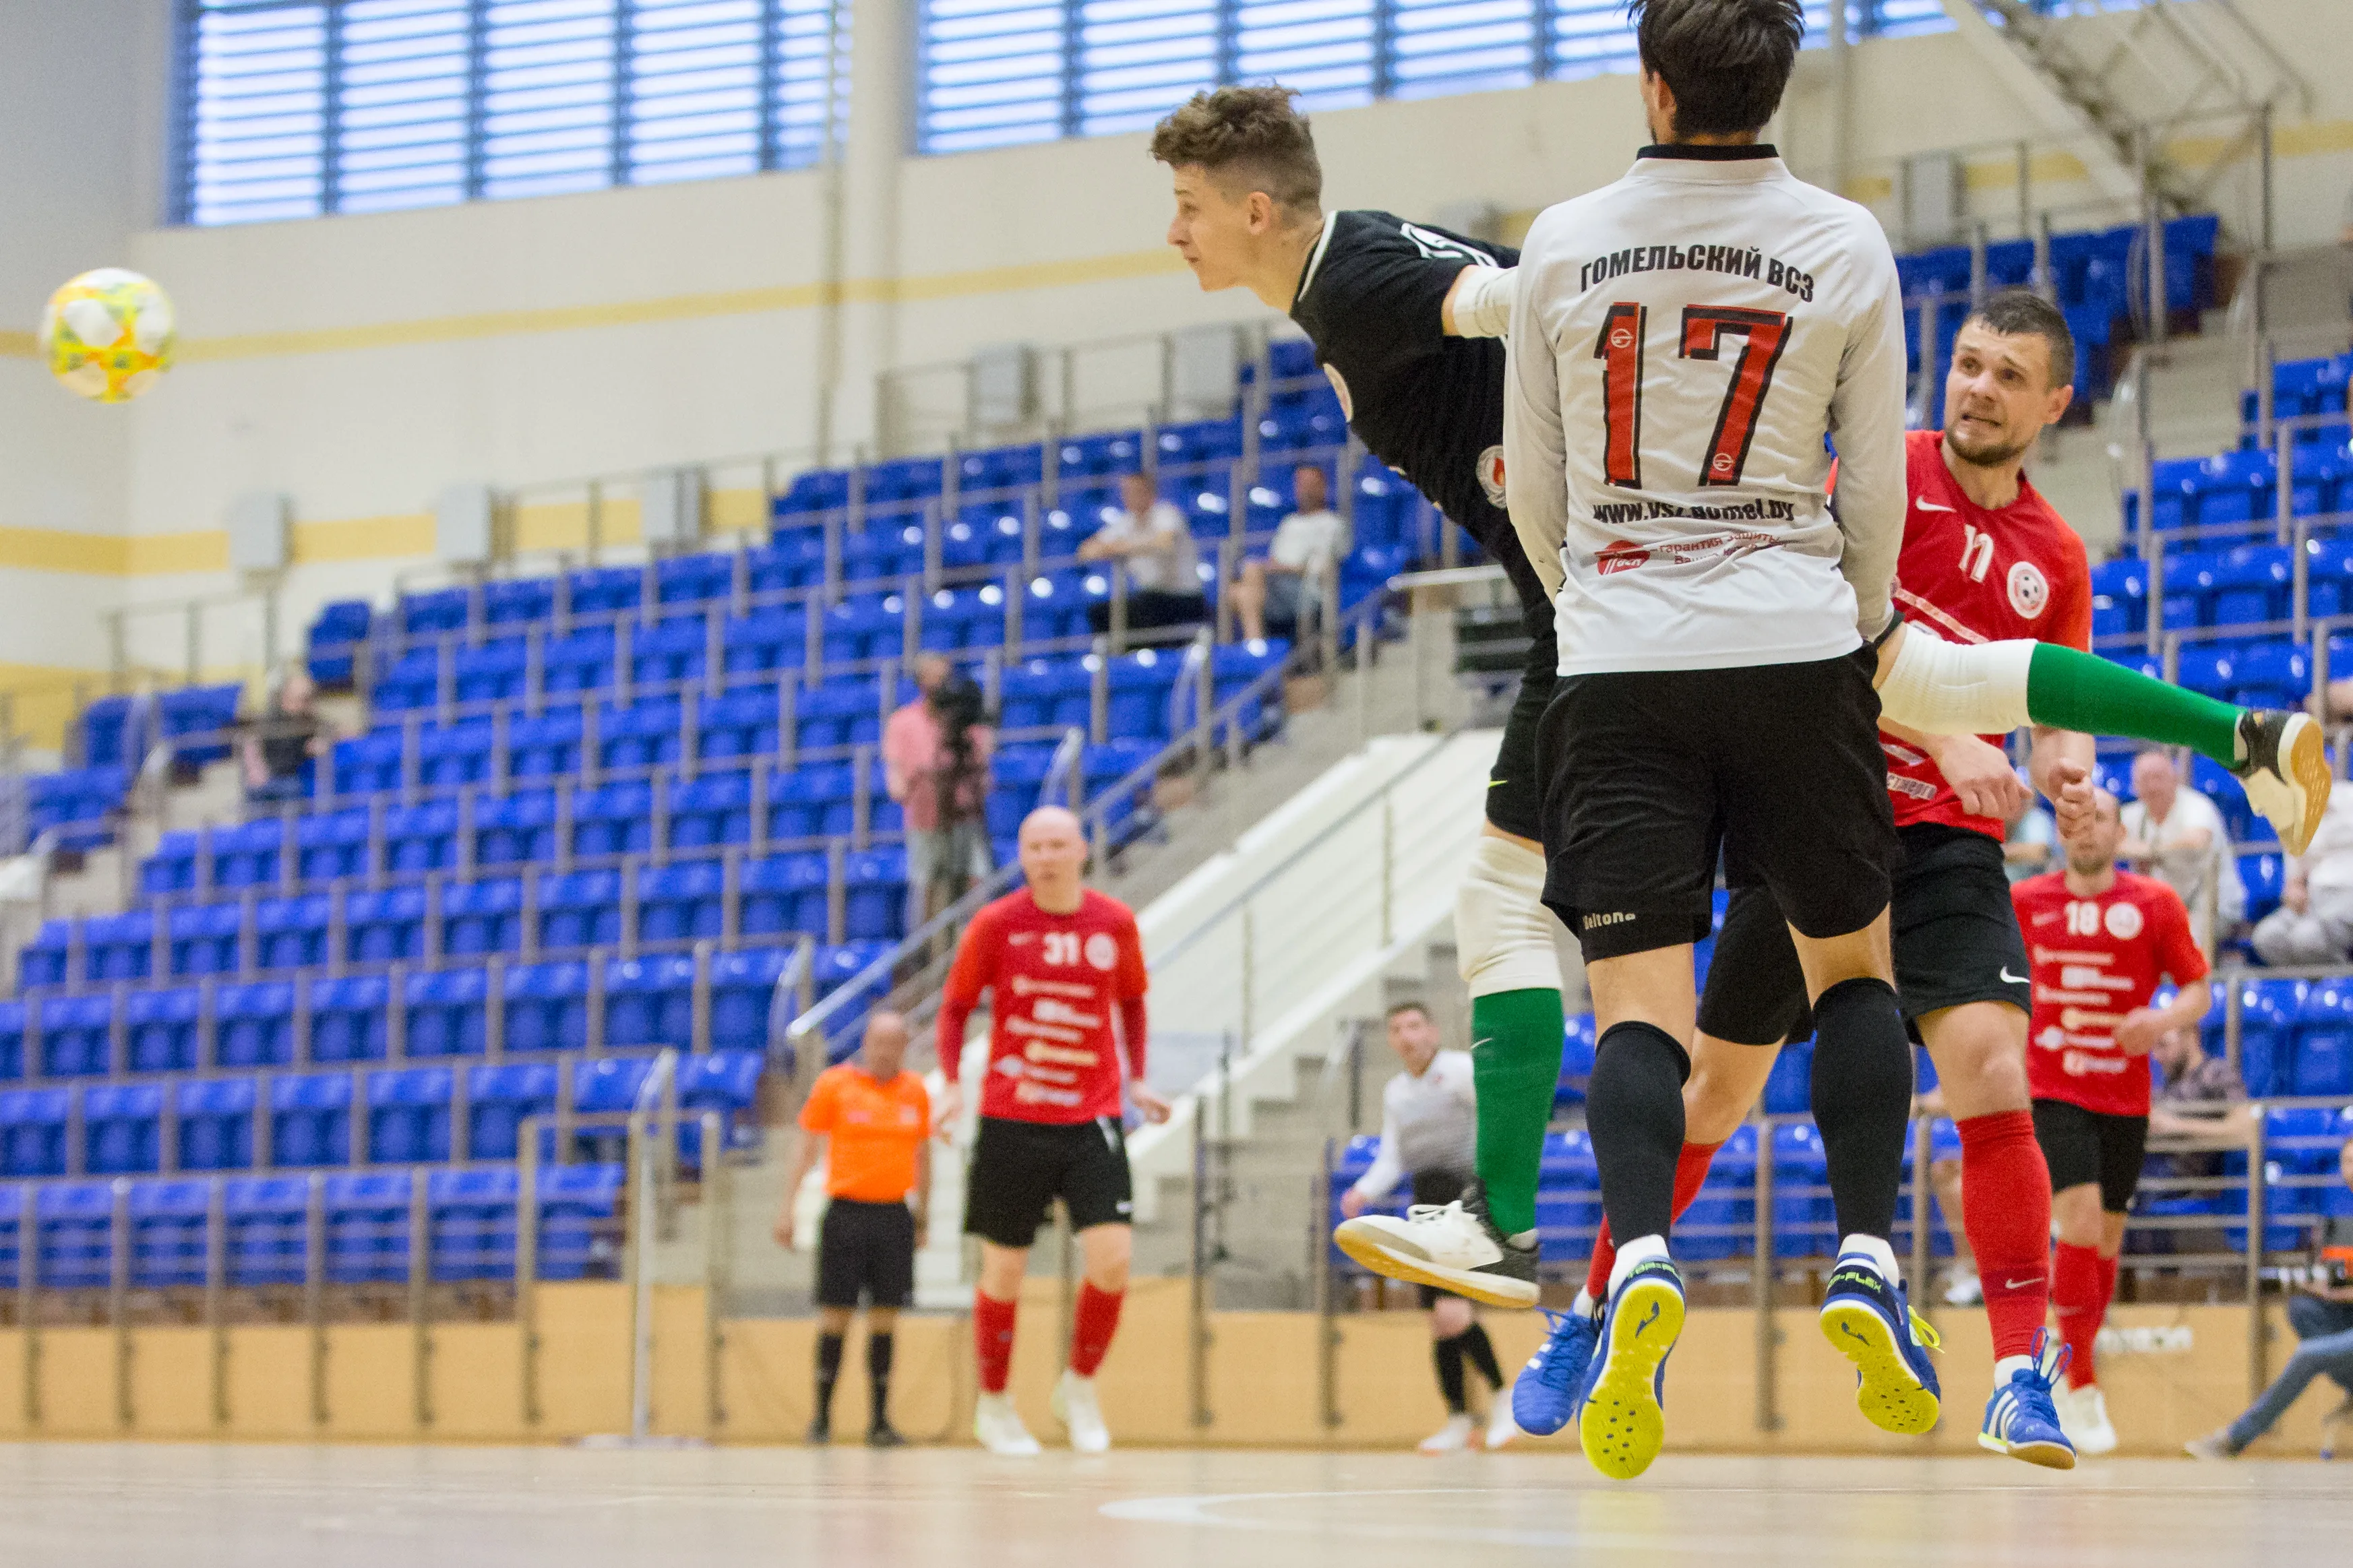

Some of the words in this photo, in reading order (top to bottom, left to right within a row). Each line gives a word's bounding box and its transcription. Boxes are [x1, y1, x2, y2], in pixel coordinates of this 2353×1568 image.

[1581, 244, 1762, 292] ГОМЕЛЬСКИЙ
[1593, 302, 1794, 489] 17
[1659, 537, 1723, 554] гарантия
[1044, 931, 1080, 966] 31
